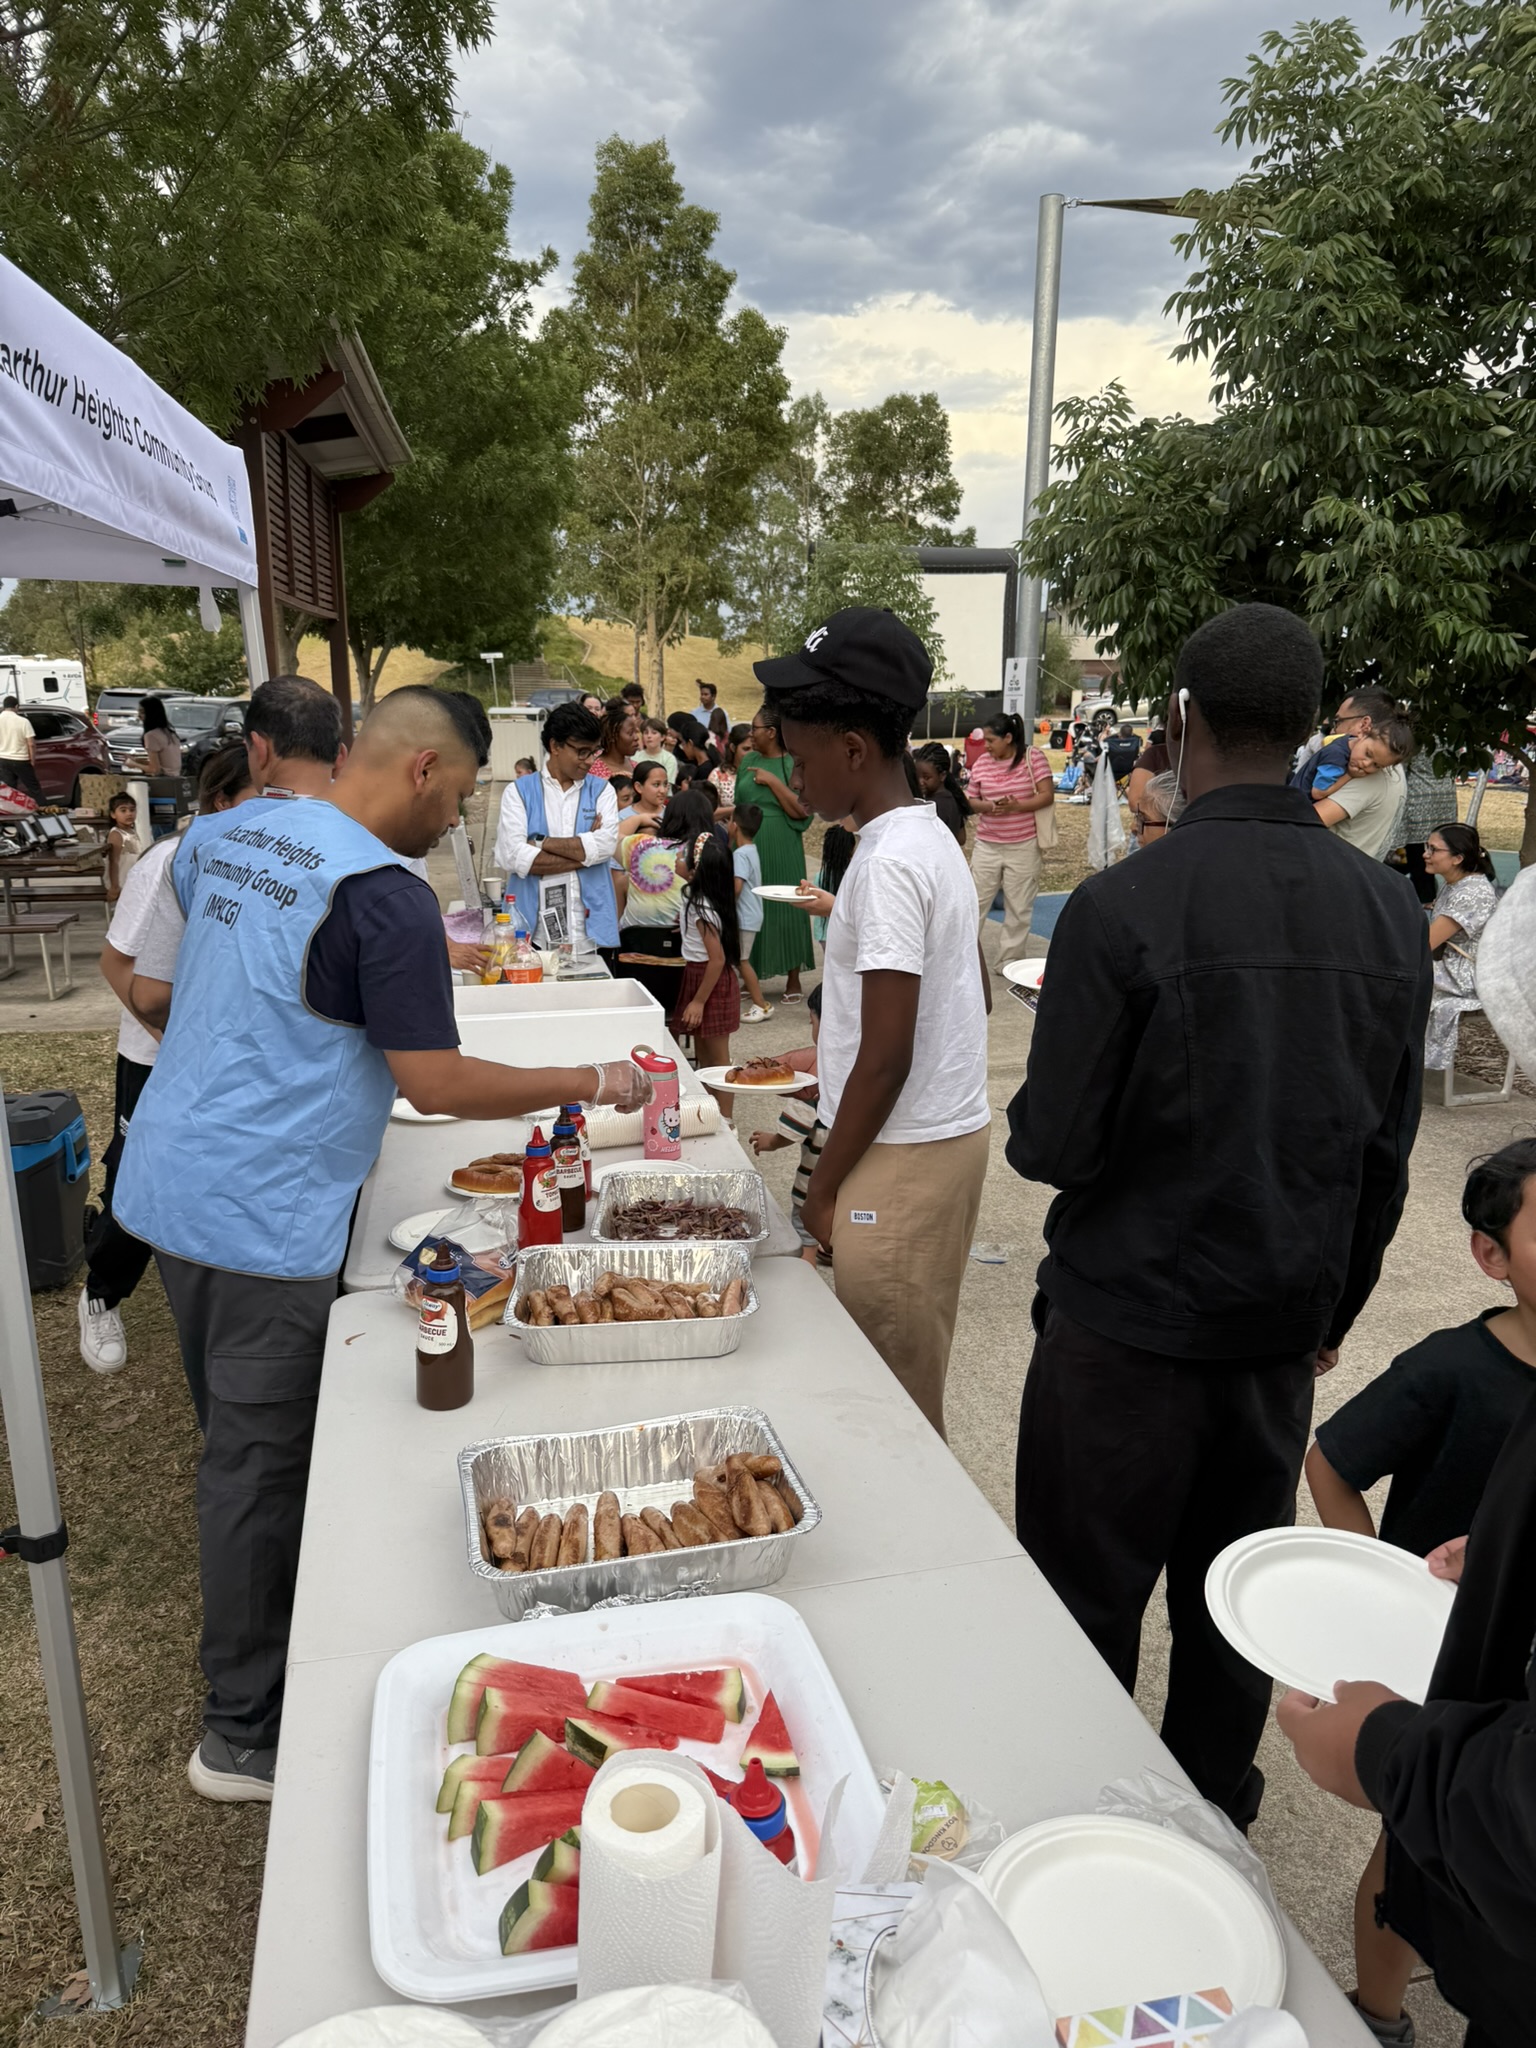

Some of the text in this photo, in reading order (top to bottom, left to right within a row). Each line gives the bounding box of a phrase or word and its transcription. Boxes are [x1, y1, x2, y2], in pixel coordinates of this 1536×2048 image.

[0, 343, 68, 407] arthur
[72, 375, 133, 446] Heights
[267, 834, 326, 870] Heights
[251, 868, 298, 911] Group
[419, 1324, 447, 1337] ARBECUE
